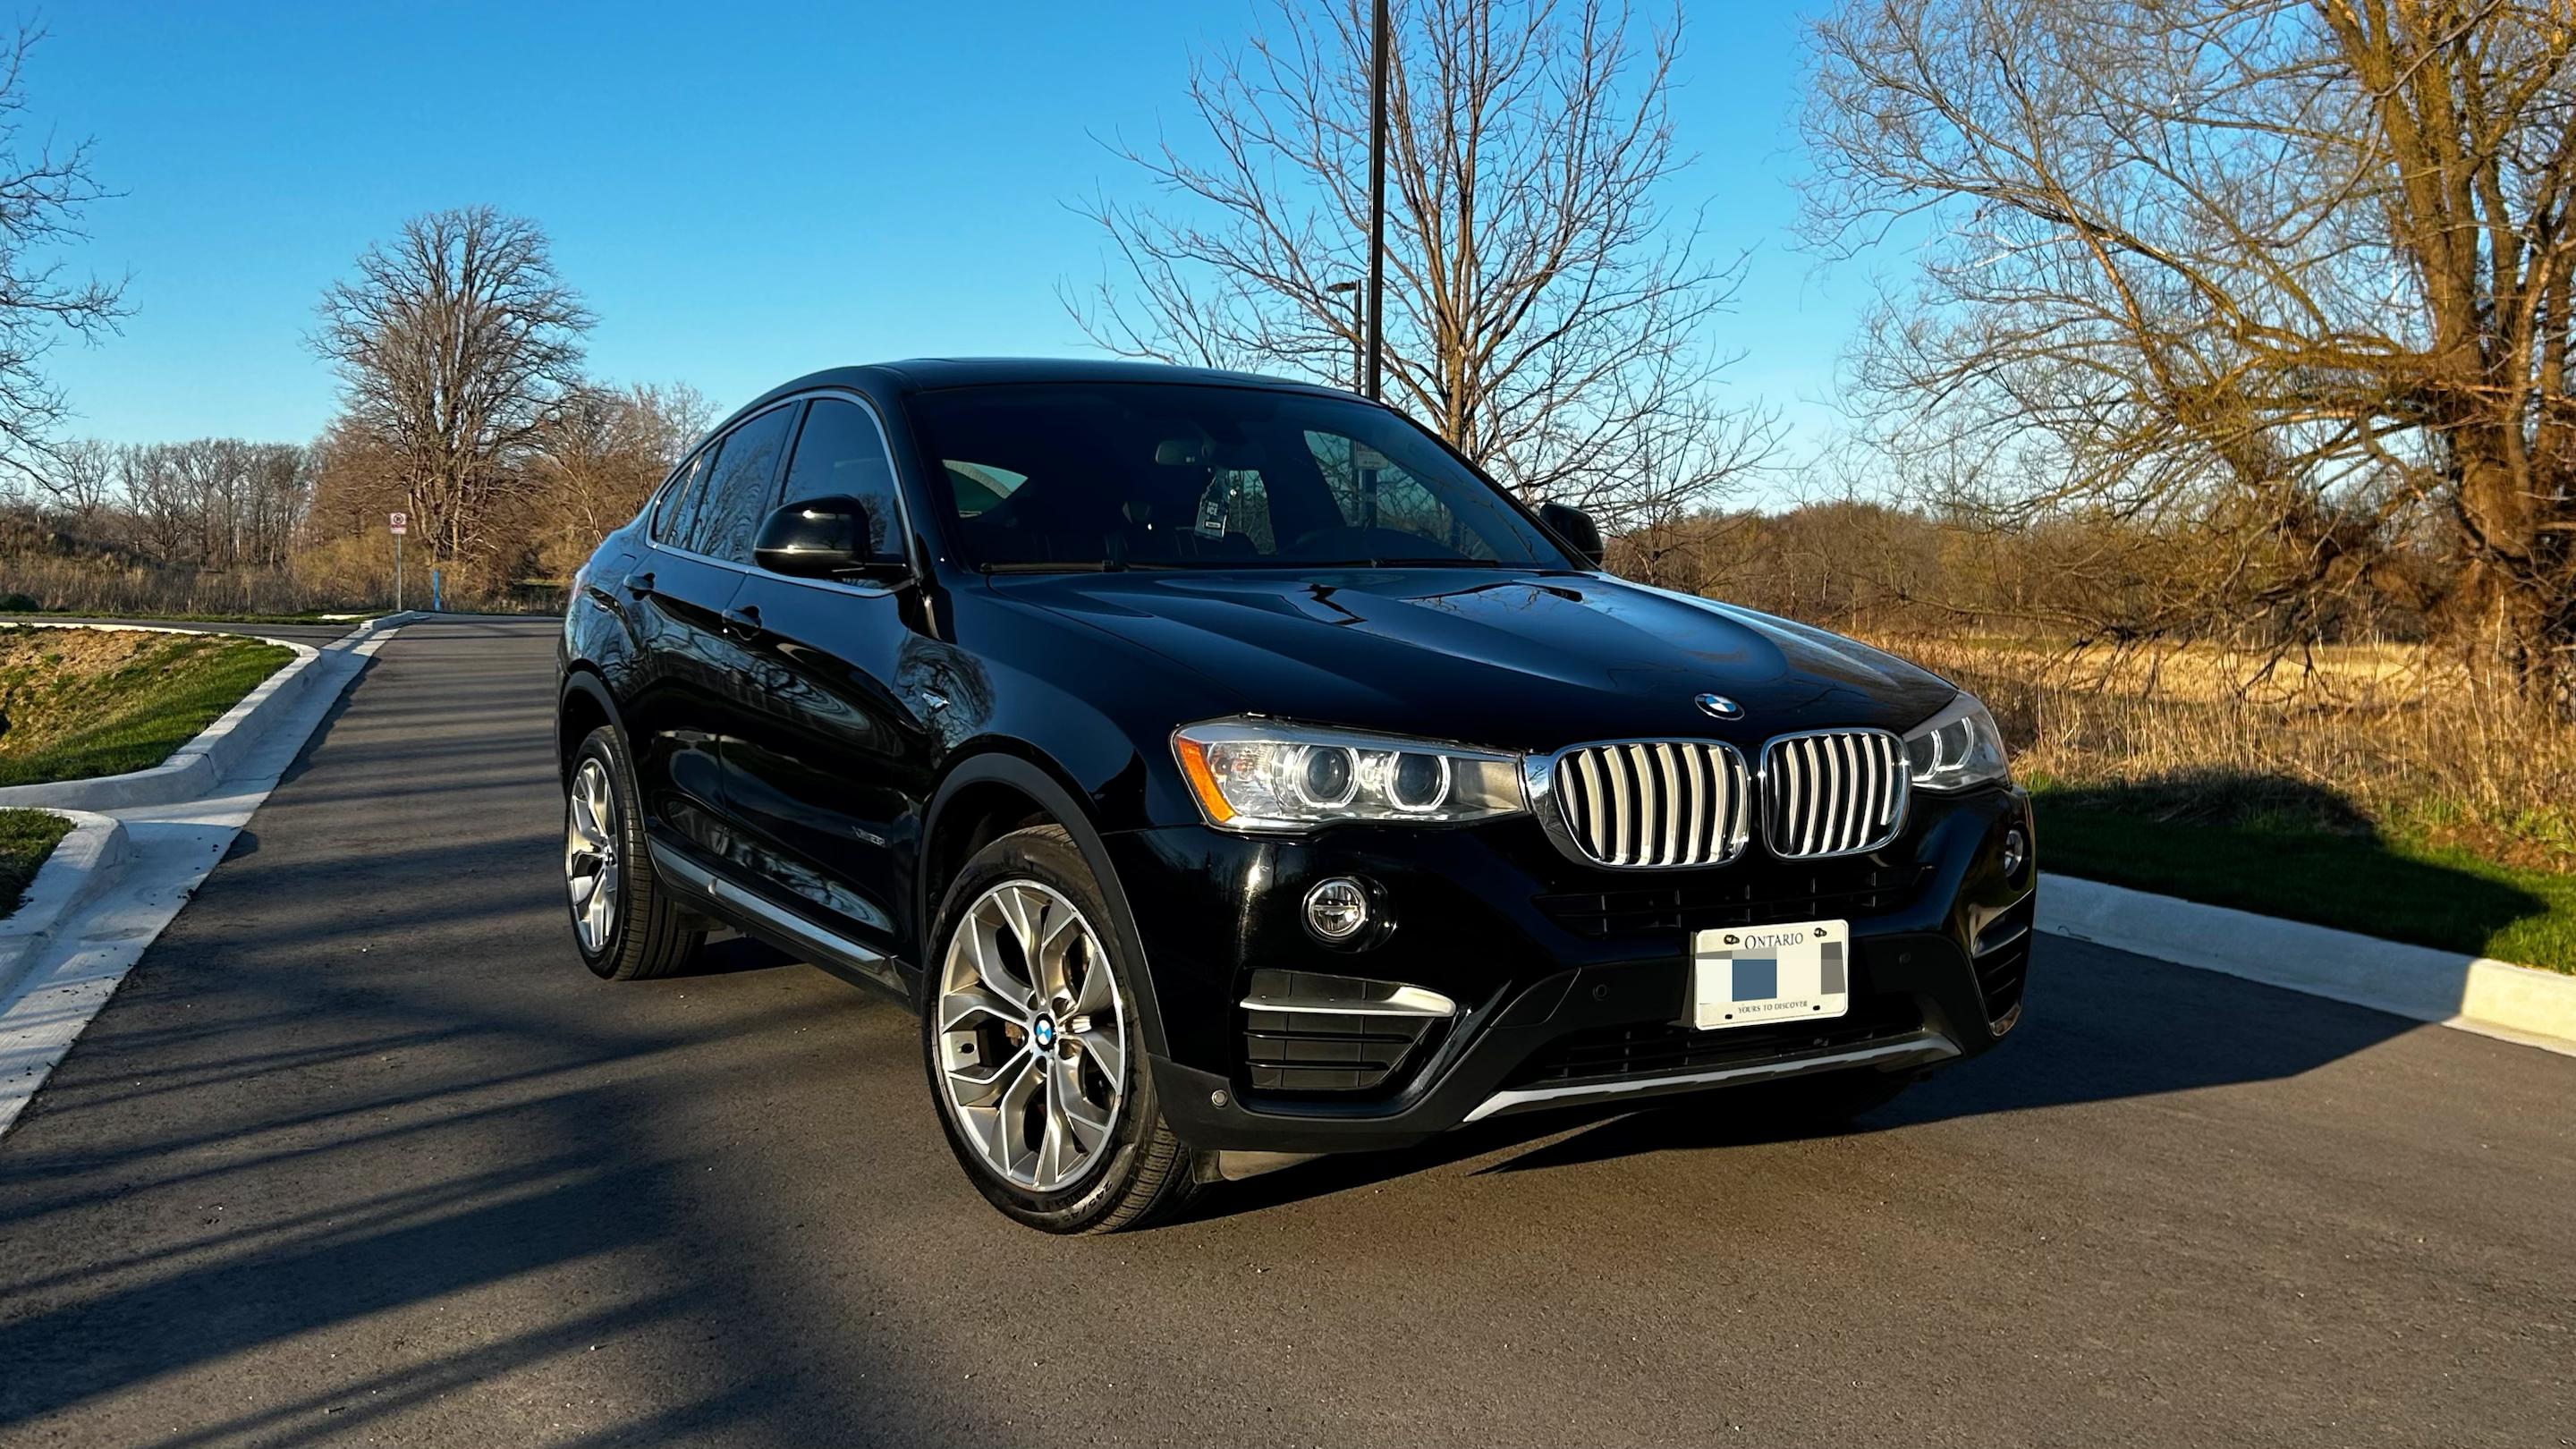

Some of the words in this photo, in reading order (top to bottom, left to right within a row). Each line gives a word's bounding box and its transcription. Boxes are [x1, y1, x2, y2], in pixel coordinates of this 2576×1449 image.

[1745, 932, 1803, 950] ONTARIO
[1738, 1004, 1760, 1013] YOURS
[1775, 1000, 1808, 1010] DISCOVER
